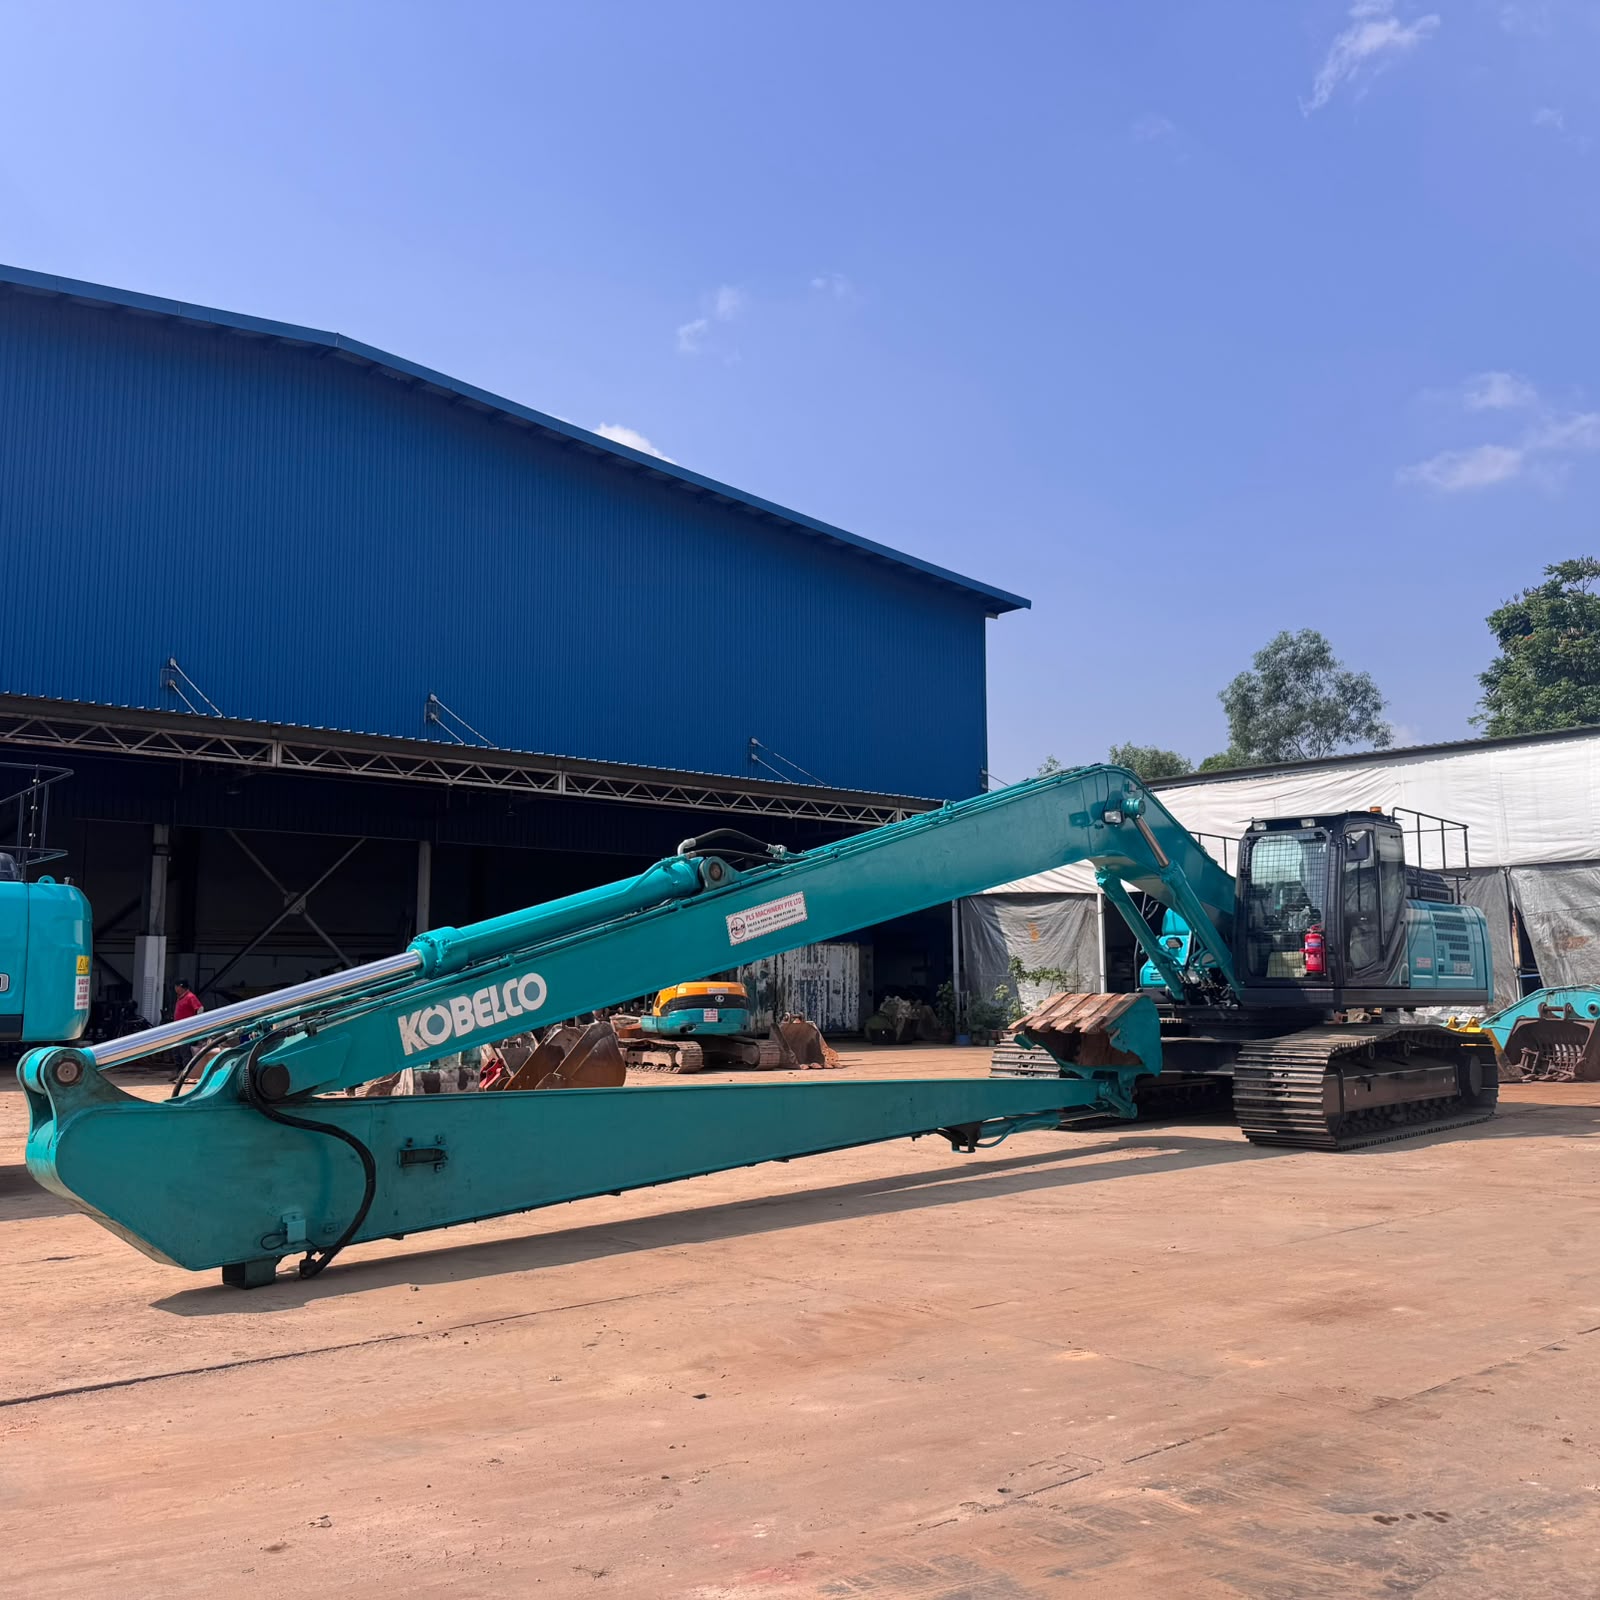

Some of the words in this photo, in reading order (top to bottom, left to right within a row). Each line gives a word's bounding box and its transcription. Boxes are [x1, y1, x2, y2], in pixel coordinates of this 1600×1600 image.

[745, 913, 755, 922] PLS
[755, 904, 784, 918] MACHINERY
[784, 901, 792, 910] PTE
[793, 897, 802, 906] LTD
[397, 972, 548, 1056] KOBELCO
